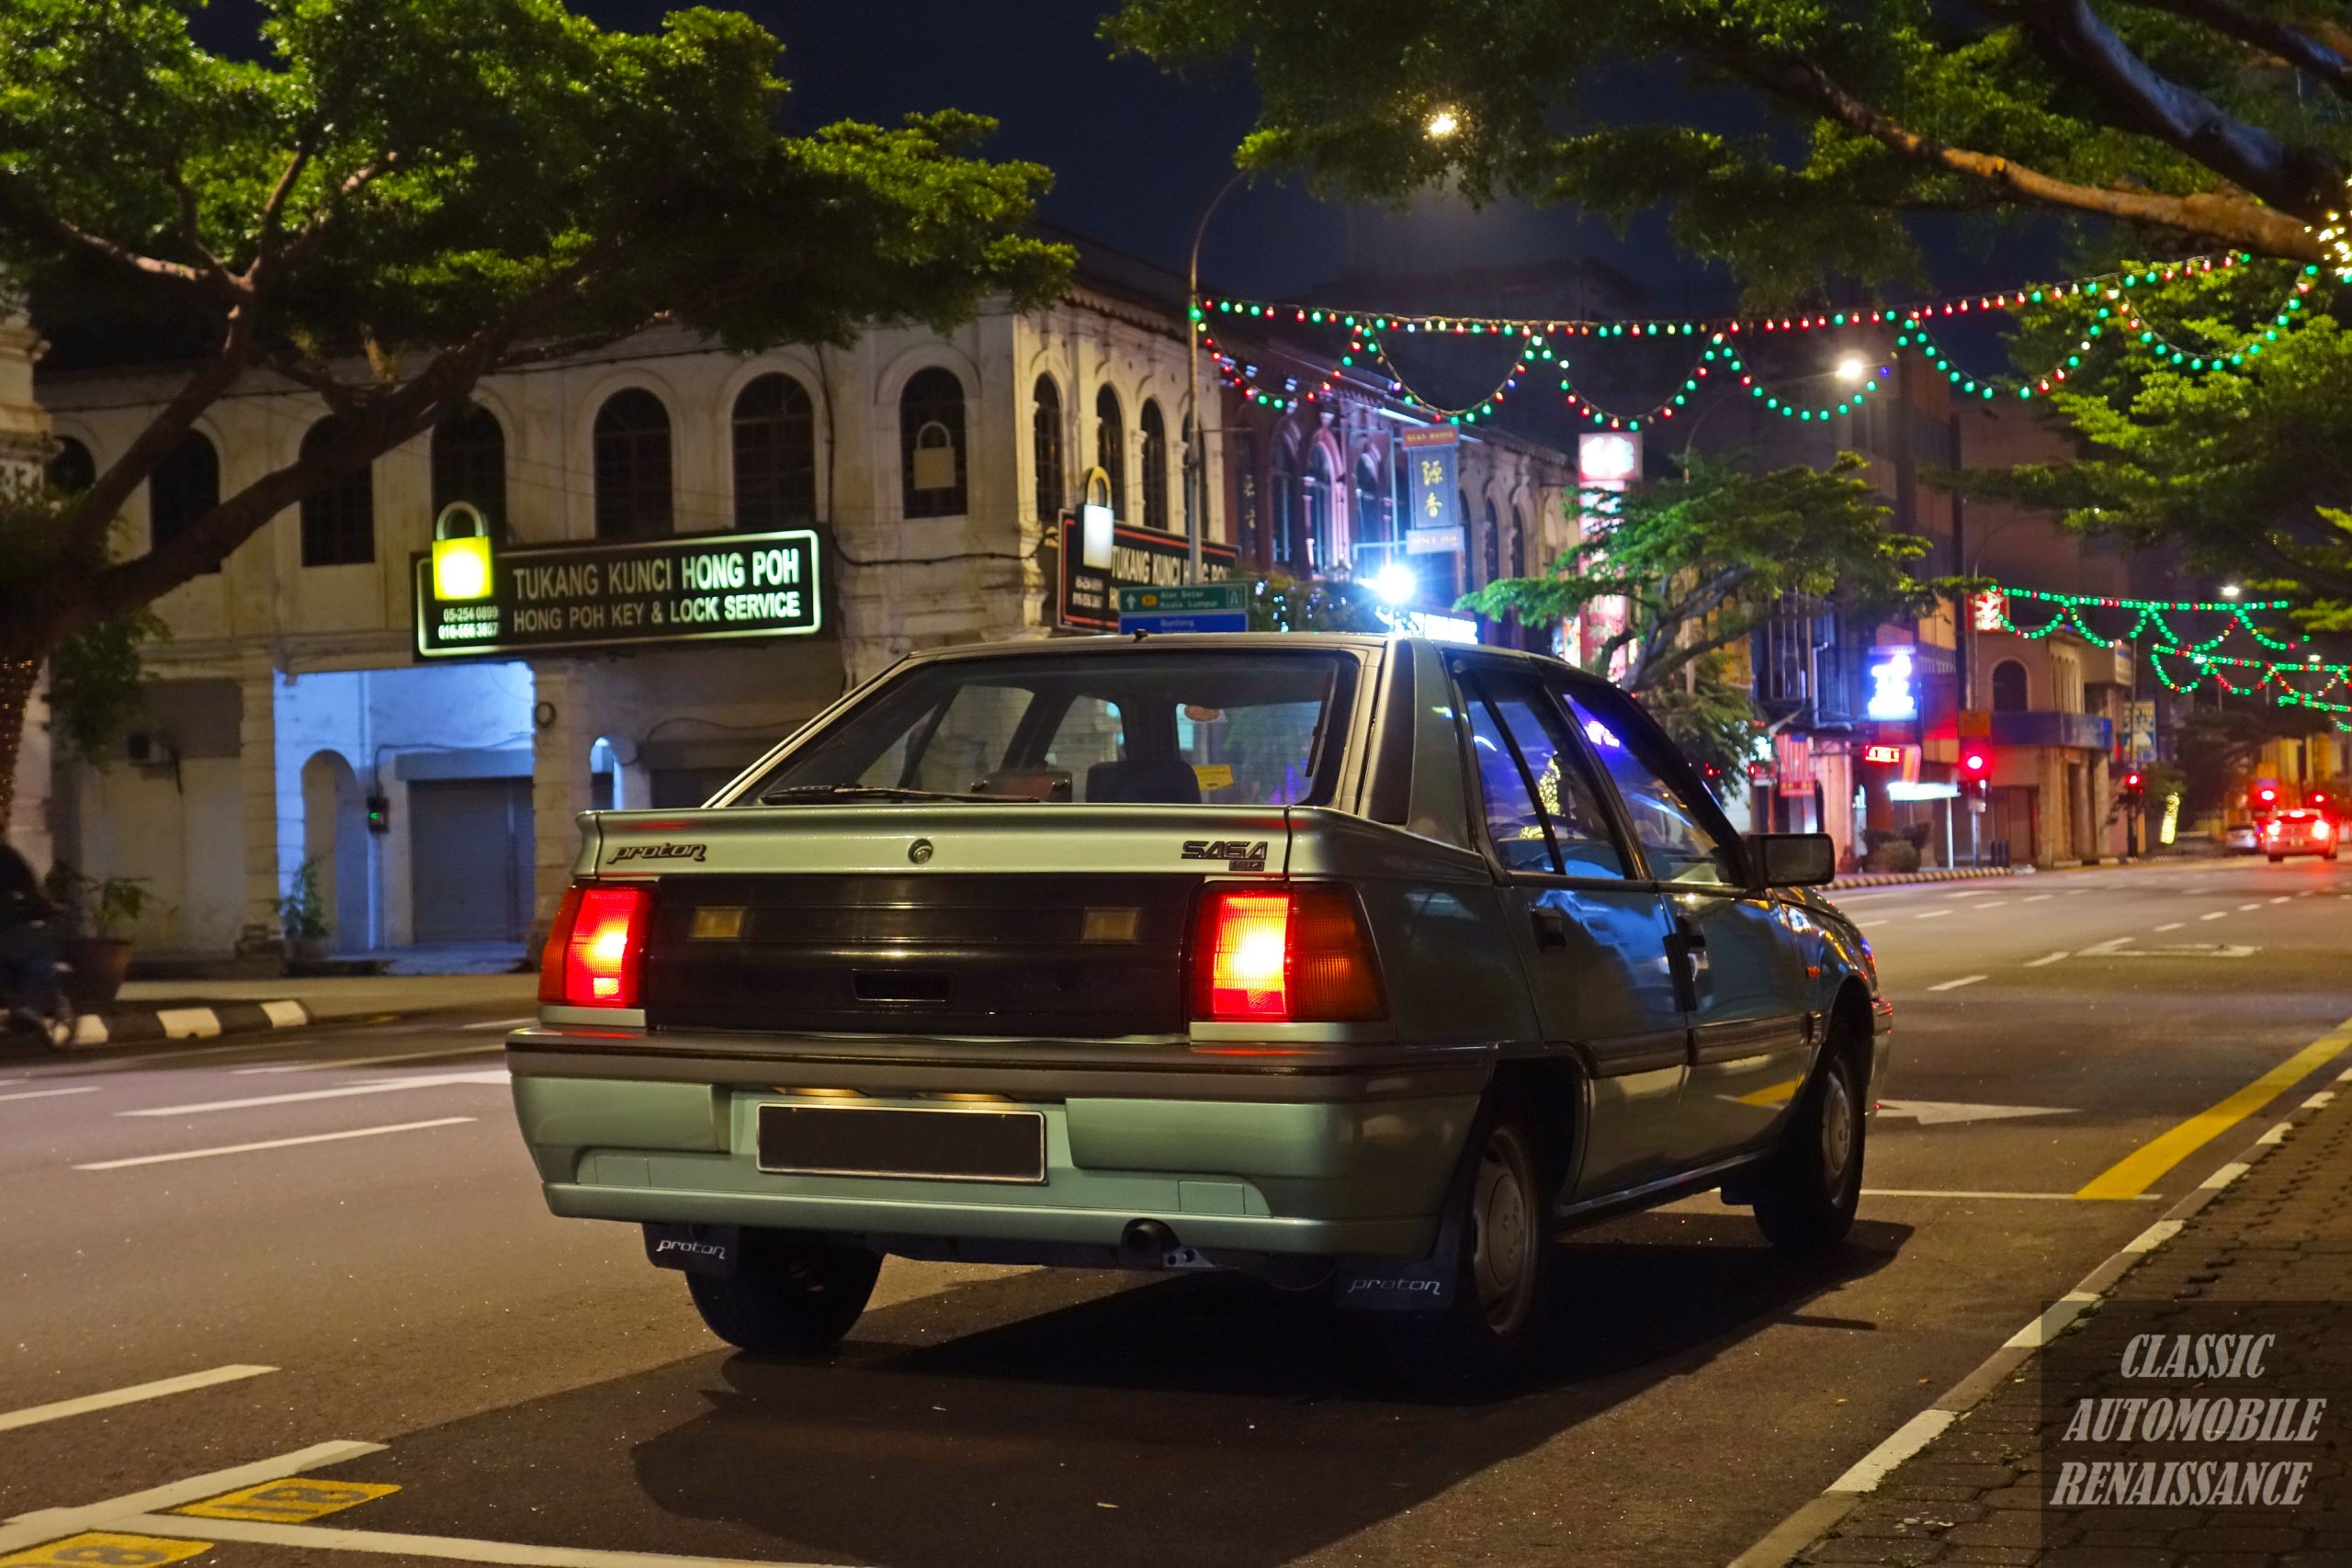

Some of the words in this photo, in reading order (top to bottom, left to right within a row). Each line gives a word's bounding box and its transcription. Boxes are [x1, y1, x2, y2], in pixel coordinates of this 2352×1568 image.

[513, 563, 598, 600] TUKANG
[608, 558, 673, 594] KUNCI
[681, 551, 746, 591] HONG
[752, 548, 800, 587] POH
[1113, 545, 1150, 584] TUKANG
[1152, 552, 1181, 586] KUNCI
[514, 607, 562, 633] HONG
[569, 604, 605, 629] POH
[611, 602, 645, 626] KEY
[650, 601, 662, 624] &
[670, 596, 720, 624] LOCK
[724, 591, 801, 622] SERVICE
[606, 842, 707, 864] proton
[1181, 840, 1268, 860] SAGA
[656, 1239, 726, 1260] proton
[1347, 1278, 1441, 1296] proton
